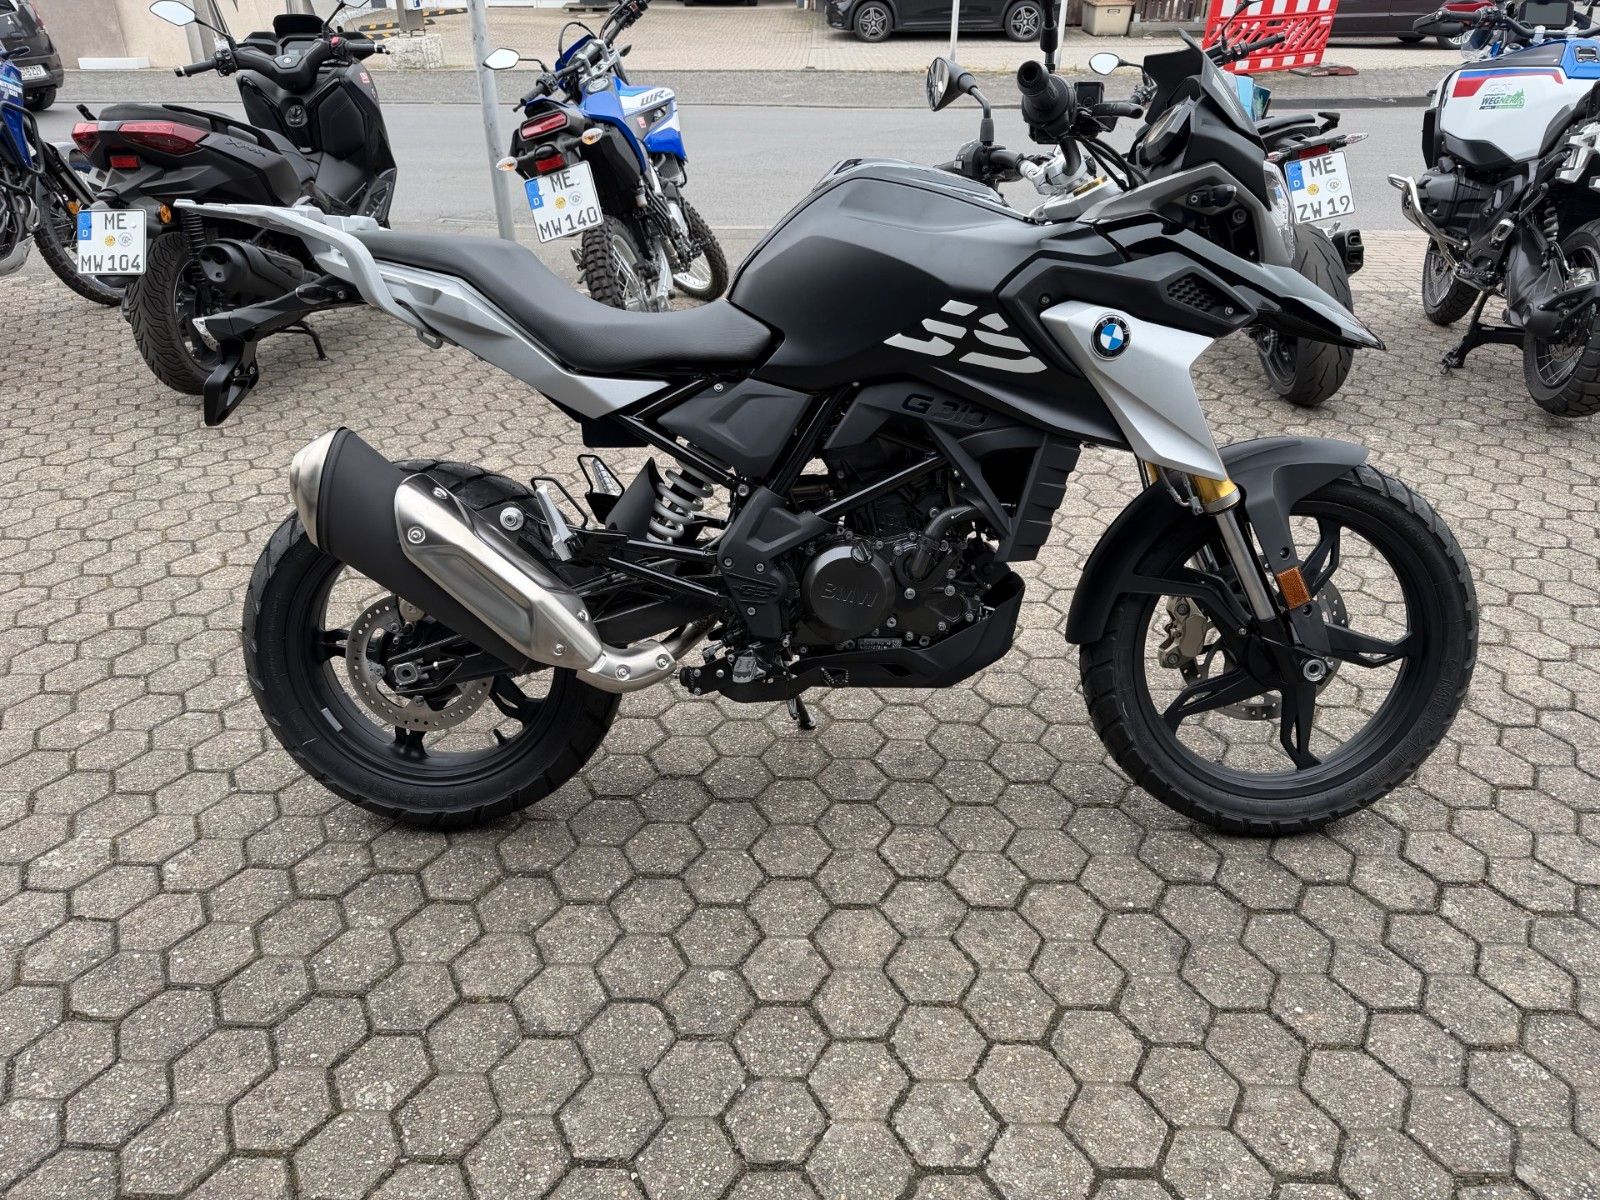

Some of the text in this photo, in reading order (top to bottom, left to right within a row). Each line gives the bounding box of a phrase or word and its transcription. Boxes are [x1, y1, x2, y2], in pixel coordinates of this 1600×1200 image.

[640, 90, 665, 107] WR
[1309, 155, 1336, 177] ME
[549, 170, 574, 193] ME
[1293, 180, 1300, 188] D
[533, 197, 540, 206] D
[1296, 195, 1350, 222] ZW 19
[104, 213, 127, 230] ME
[538, 206, 598, 240] MW 140
[82, 229, 89, 237] D
[81, 254, 141, 272] MW 104
[820, 582, 879, 607] BMW
